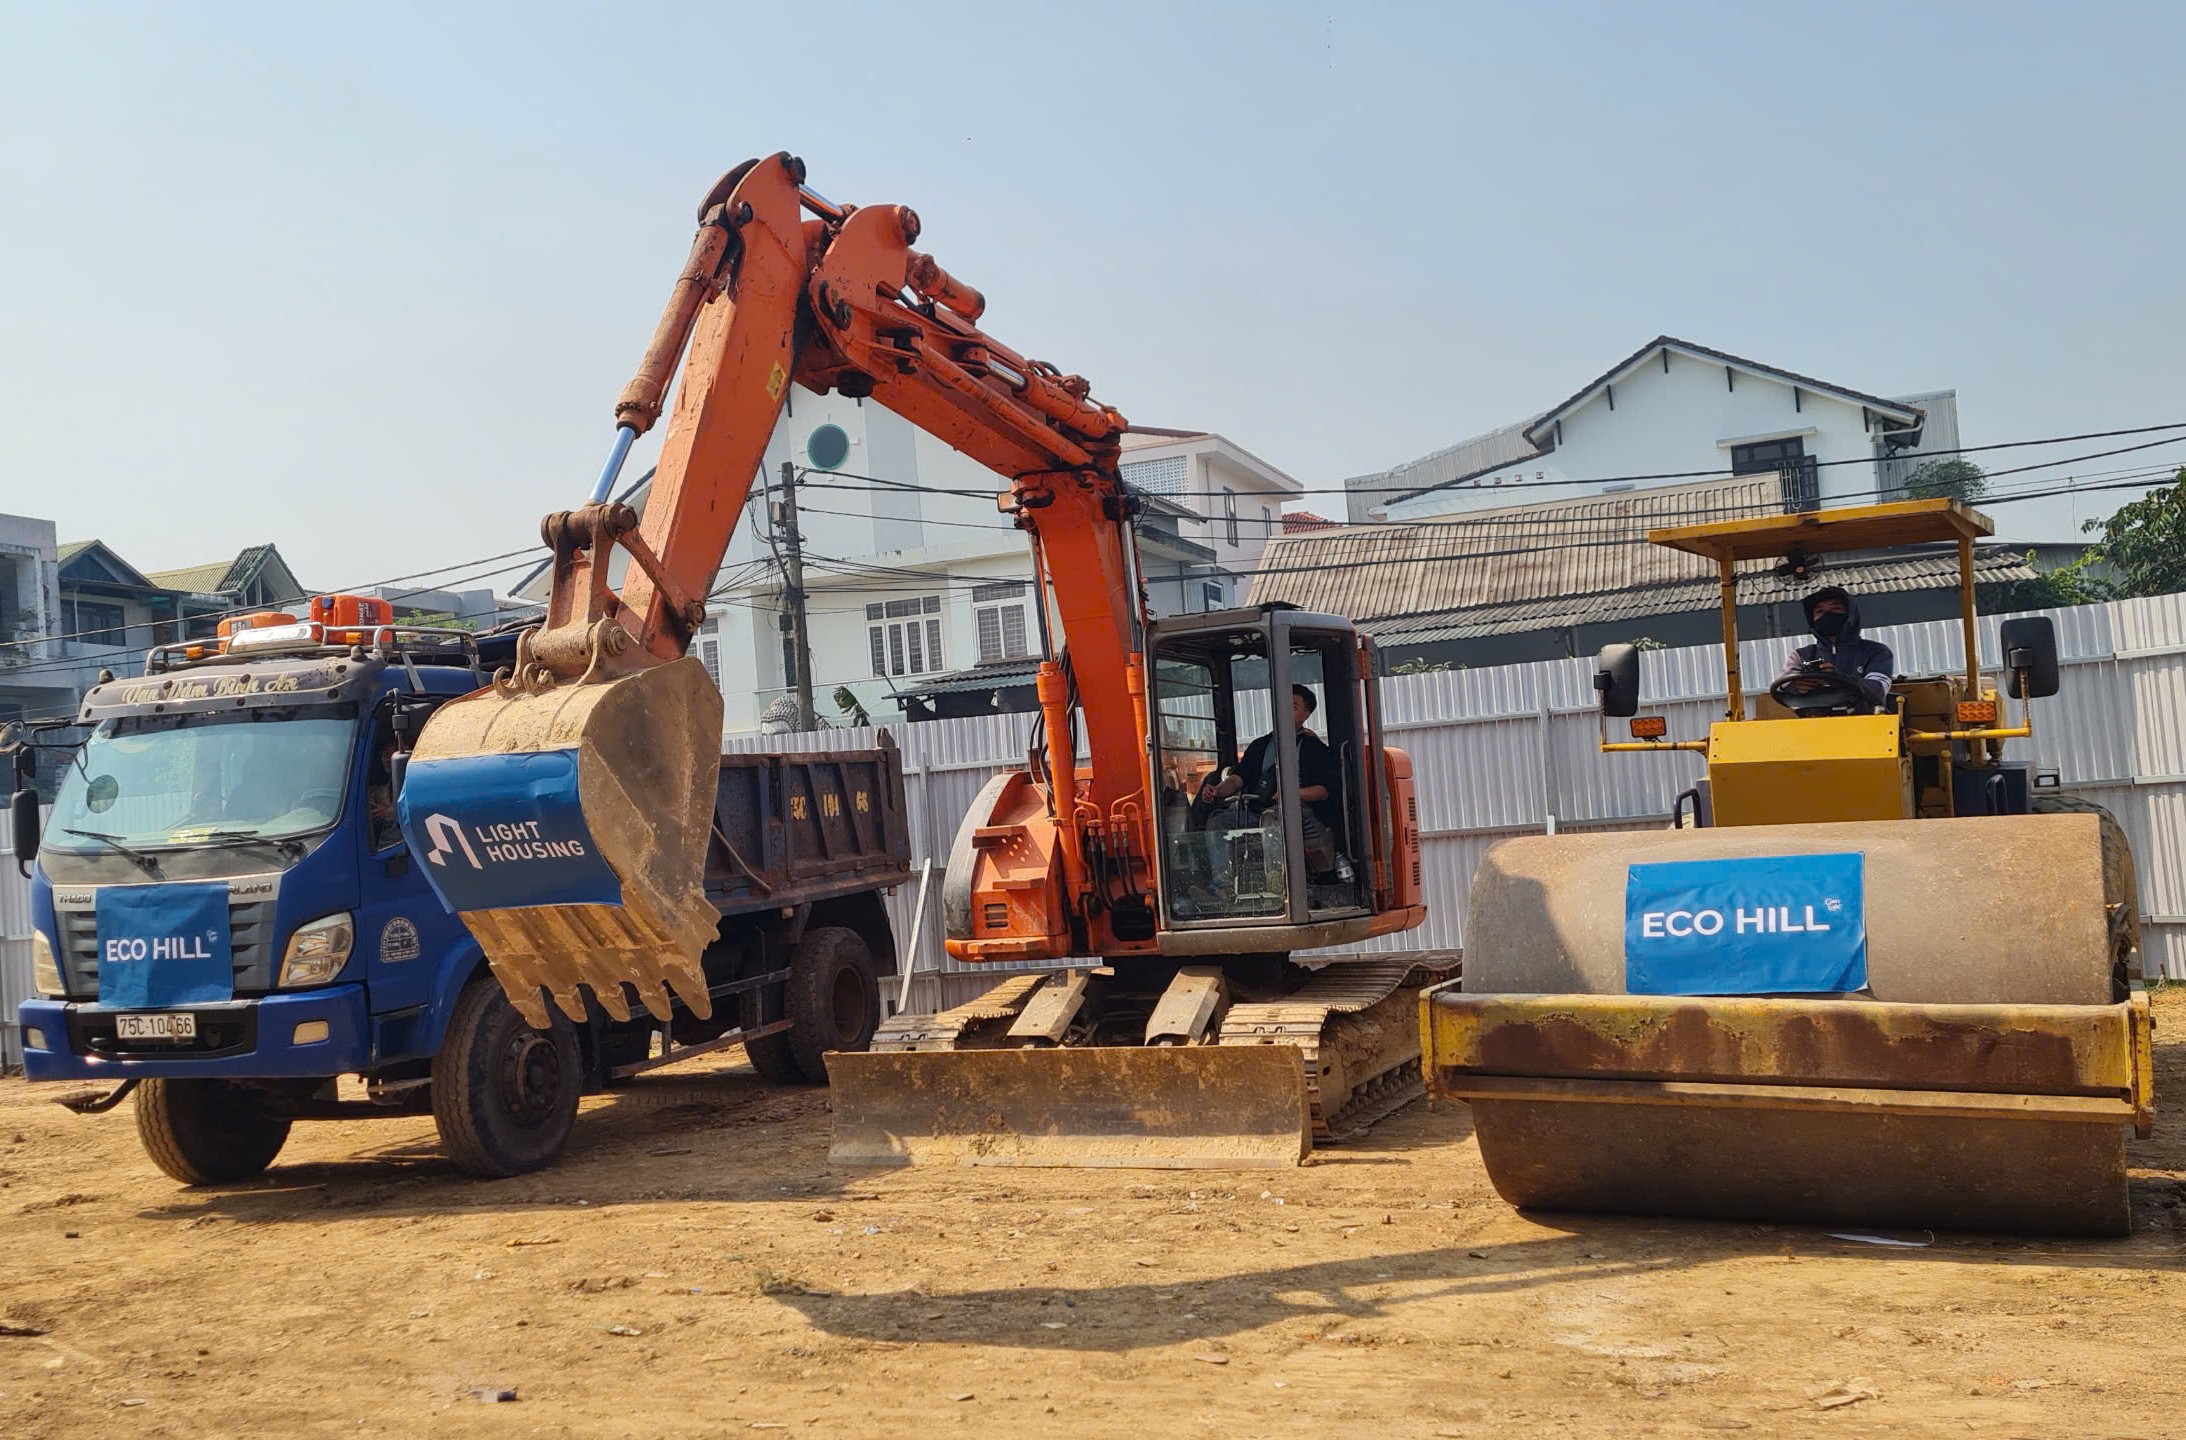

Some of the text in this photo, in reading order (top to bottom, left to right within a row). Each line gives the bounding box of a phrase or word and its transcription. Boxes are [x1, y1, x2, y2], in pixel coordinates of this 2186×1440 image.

[475, 820, 542, 843] LIGHT
[485, 839, 586, 863] HOUSING
[1643, 909, 1725, 938] ECO
[1736, 904, 1830, 935] HILL
[106, 938, 148, 962] ECO
[152, 936, 212, 960] HILL
